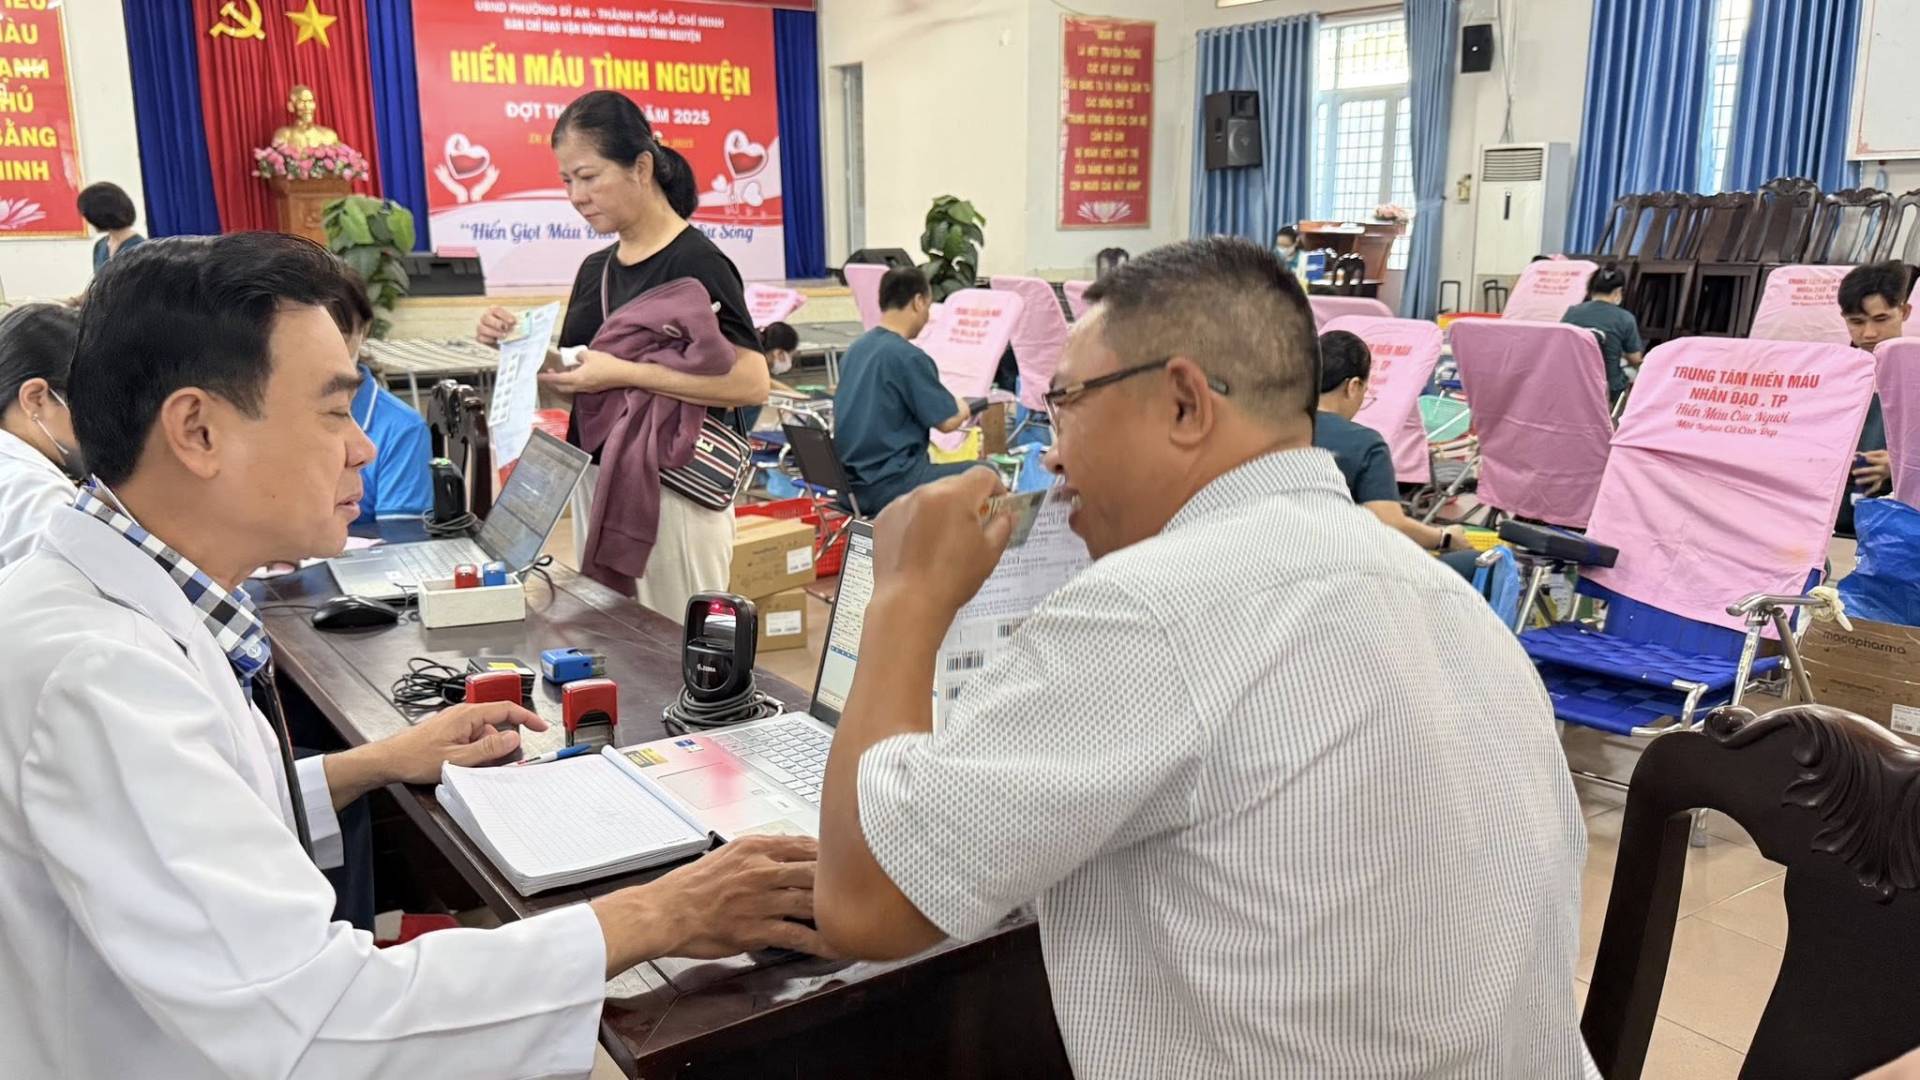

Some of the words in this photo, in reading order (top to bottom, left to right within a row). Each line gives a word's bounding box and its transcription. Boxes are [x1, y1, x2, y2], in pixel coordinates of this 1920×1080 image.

[0, 16, 38, 45] ÀU
[450, 42, 517, 85] HIẾN
[523, 48, 585, 88] MÁU
[590, 52, 650, 91] TÌNH
[654, 59, 751, 101] NGUYỆN
[504, 101, 541, 122] ĐỢT
[544, 102, 566, 119] TH
[673, 108, 711, 126] 2025
[0, 159, 49, 181] INH
[1673, 366, 1716, 382] TRUNG
[1719, 369, 1748, 386] TÂM
[1751, 369, 1784, 388] HIẾN
[1787, 372, 1820, 389] MÁU
[1689, 386, 1727, 403] NHÂN
[1730, 390, 1759, 408] ĐẠO
[1771, 394, 1788, 408] TP
